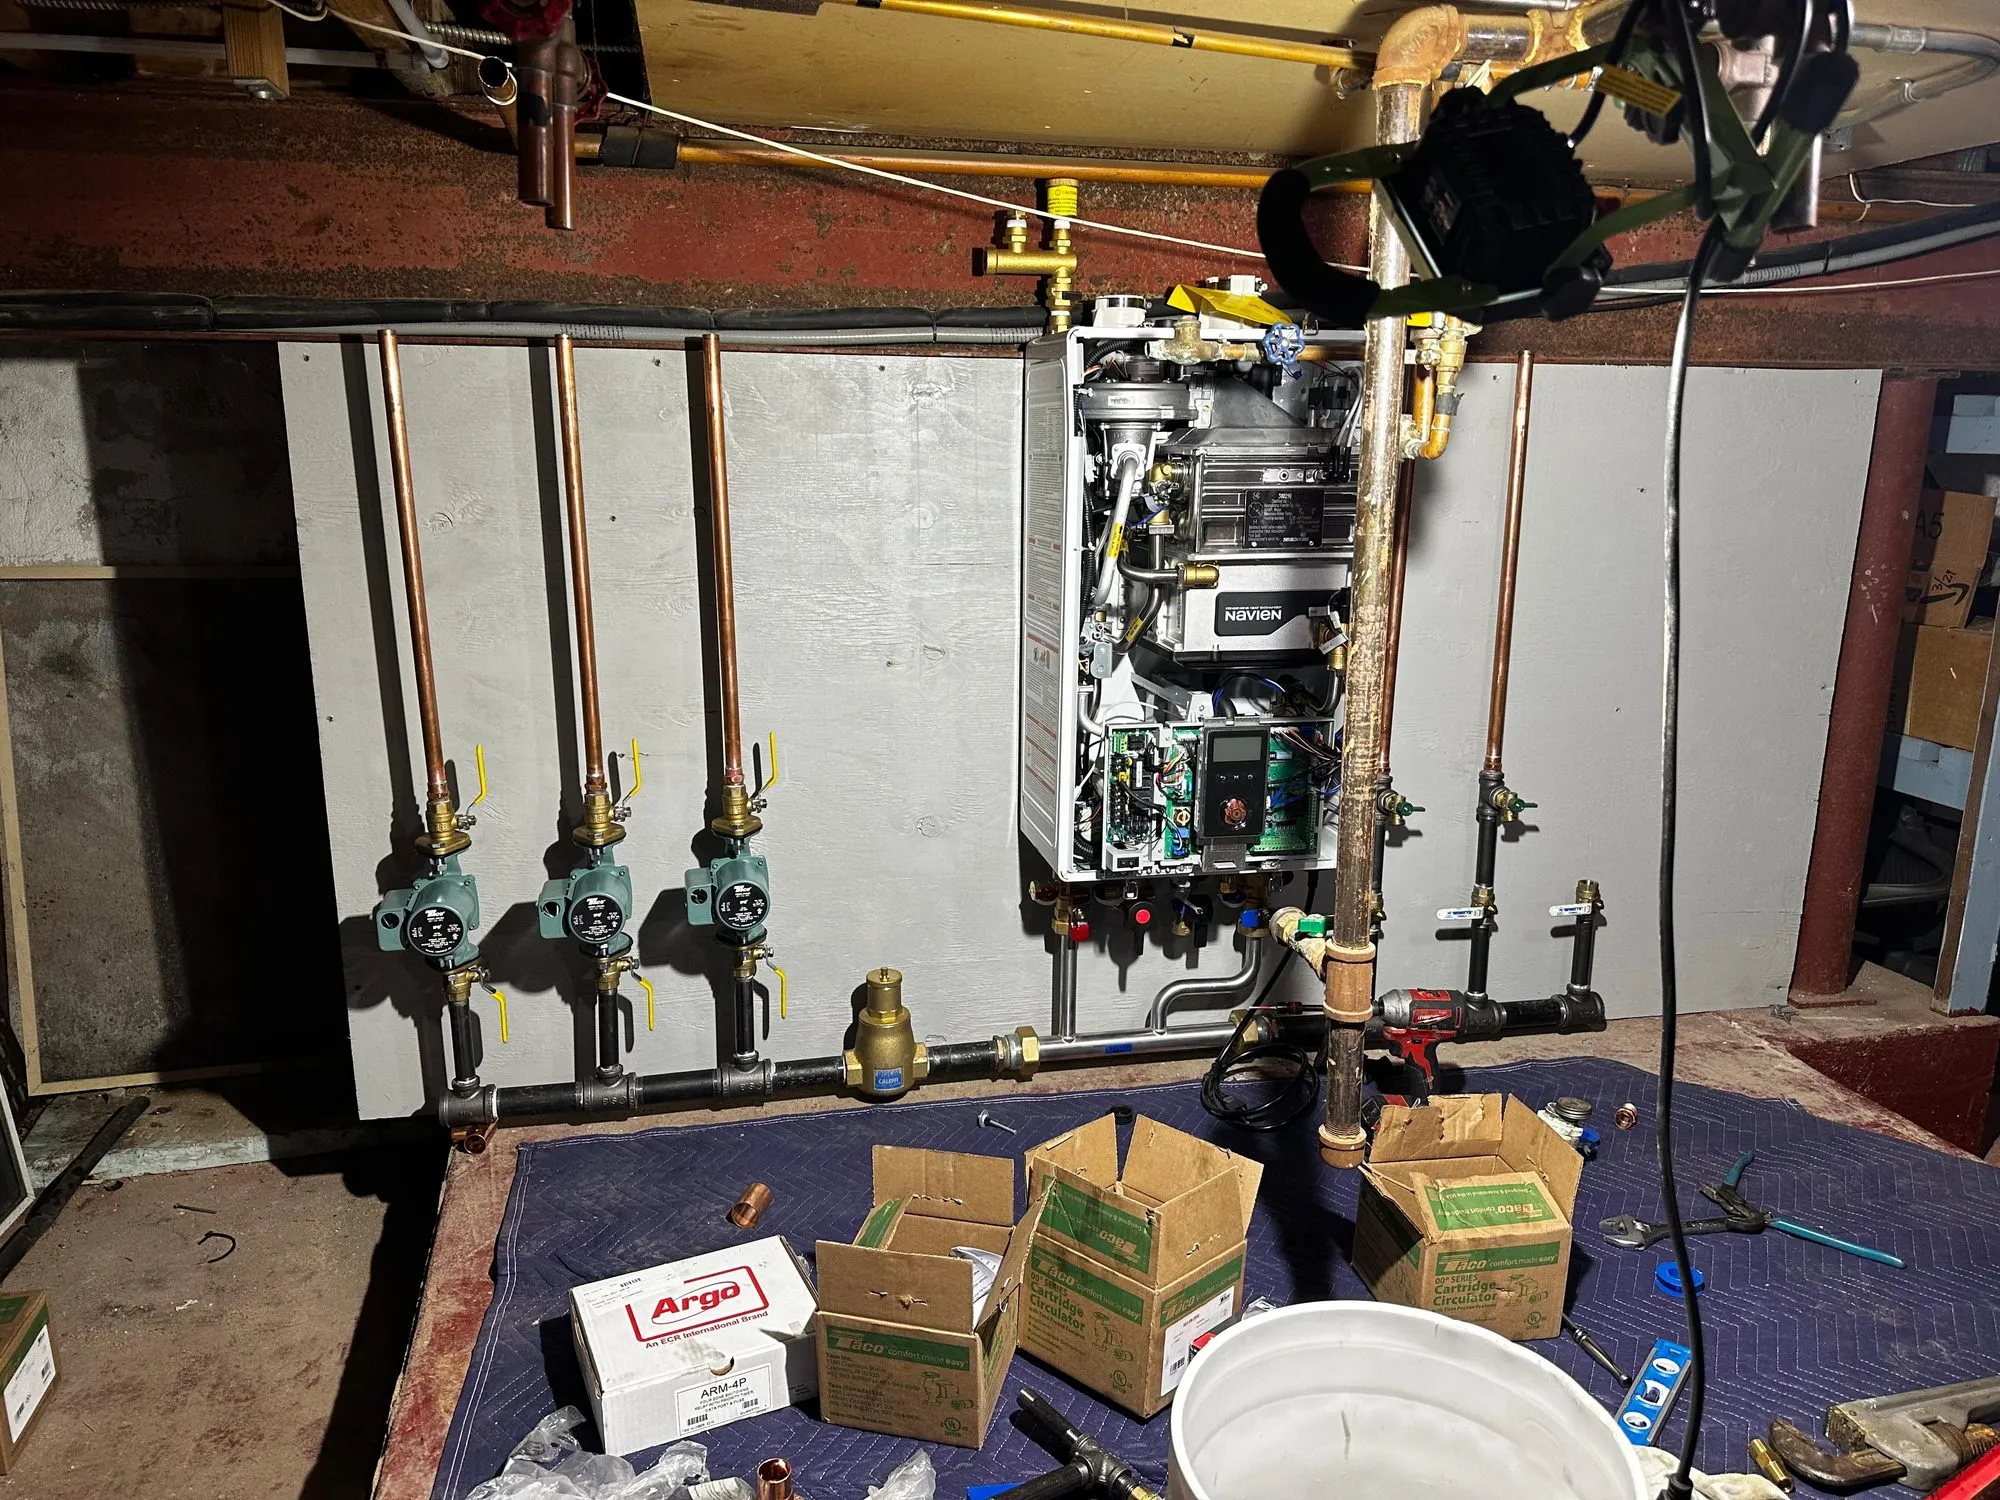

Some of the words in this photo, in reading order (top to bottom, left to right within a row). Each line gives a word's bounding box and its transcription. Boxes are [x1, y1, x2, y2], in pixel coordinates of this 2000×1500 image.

[1033, 1249, 1075, 1286] Taco
[1077, 1284, 1103, 1300] comfort
[1438, 1254, 1487, 1272] Taco
[1490, 1257, 1518, 1267] comfort
[1519, 1256, 1538, 1264] made
[1538, 1255, 1556, 1264] easy
[1044, 1279, 1068, 1297] SERIES
[1434, 1281, 1497, 1295] Cartridge
[1451, 1274, 1478, 1283] SERIES
[652, 1281, 740, 1319] Argo
[1030, 1282, 1084, 1318] Cartridge
[1030, 1294, 1085, 1331] Circulator
[1433, 1292, 1497, 1307] Circulator
[645, 1341, 659, 1349] An
[660, 1335, 682, 1345] ECR
[683, 1319, 740, 1339] International
[741, 1311, 769, 1322] Brand
[830, 1330, 885, 1354] Taco
[888, 1349, 920, 1361] comfort
[945, 1359, 966, 1368] easy
[701, 1378, 747, 1399] ARM-4P
